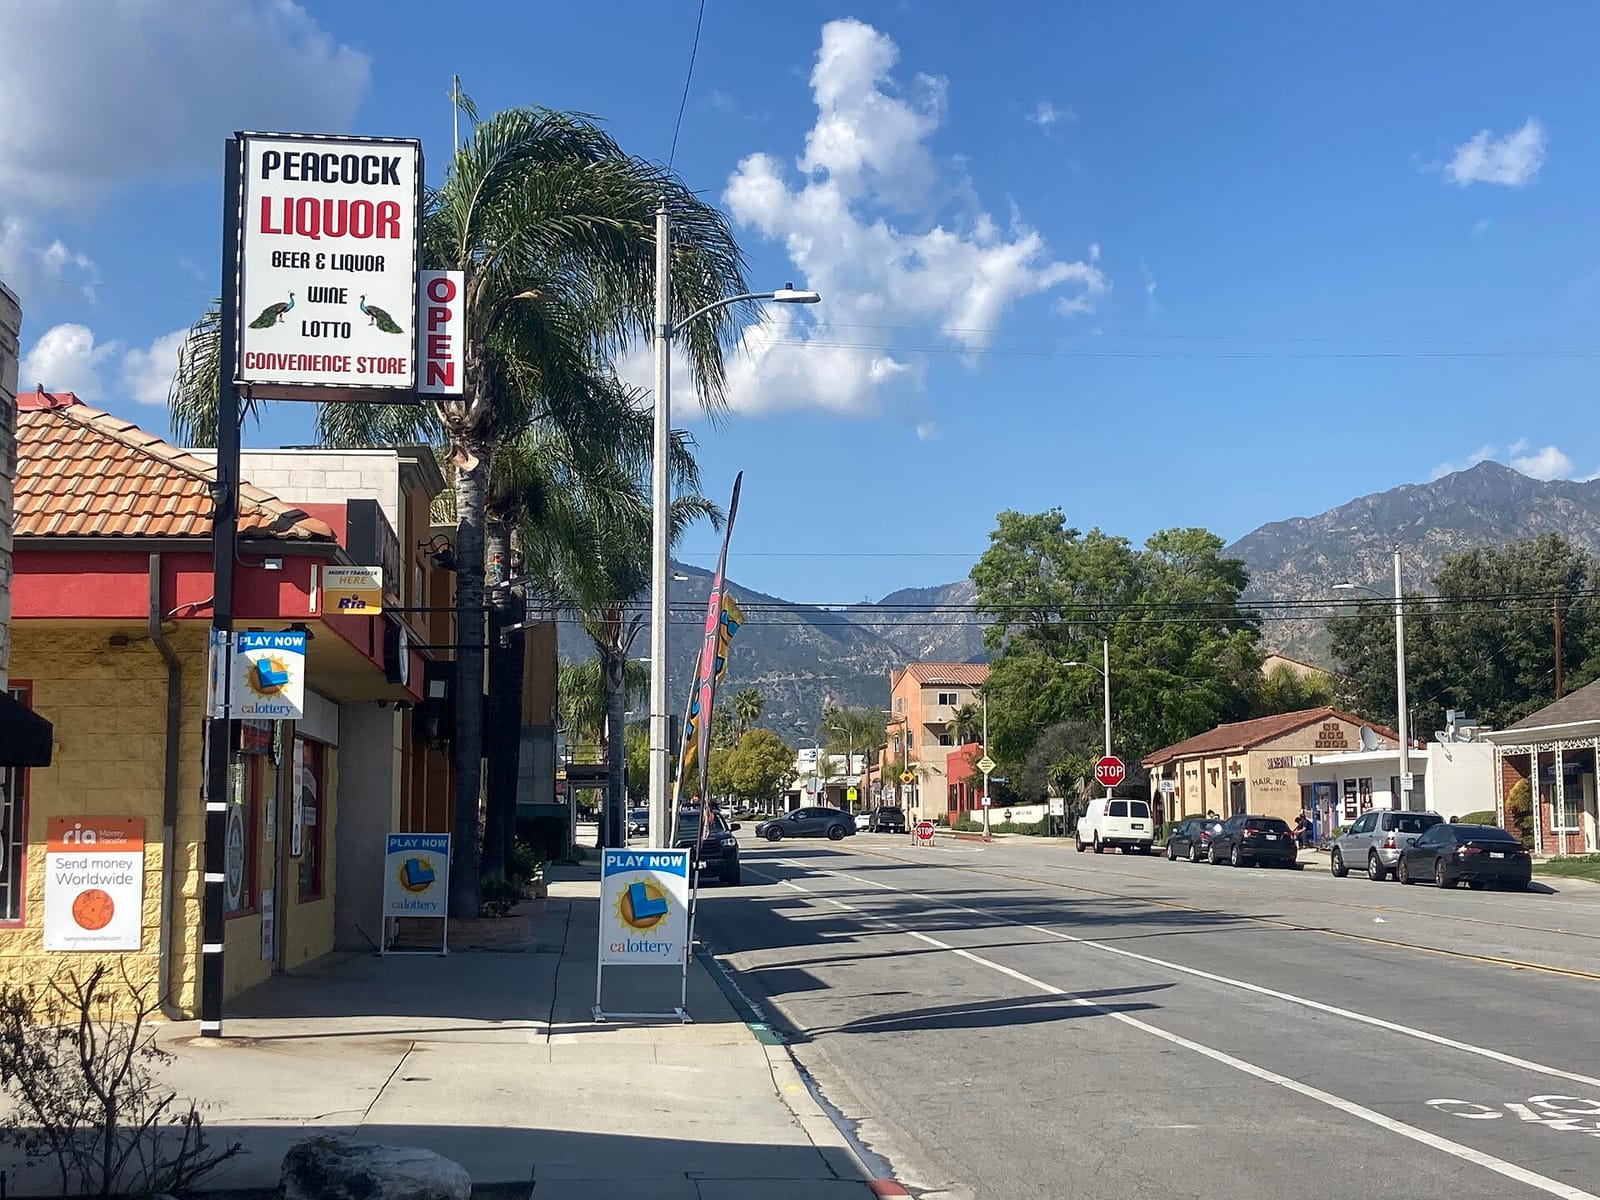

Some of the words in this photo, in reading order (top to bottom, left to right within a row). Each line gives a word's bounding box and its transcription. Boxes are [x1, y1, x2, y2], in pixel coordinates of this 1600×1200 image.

[261, 150, 401, 185] PEACOCK
[260, 196, 400, 240] LIQUOR
[272, 250, 310, 269] BEER
[315, 253, 325, 270] &
[331, 254, 385, 272] LIQUOR
[307, 286, 348, 305] WINE
[302, 320, 351, 339] LOTTO
[427, 278, 456, 387] OPEN
[245, 352, 351, 373] CONVENIENCE
[357, 356, 407, 375] STORE
[339, 576, 368, 585] HERE
[338, 593, 366, 609] Ria
[239, 636, 271, 647] PLAY
[274, 636, 304, 647] NOW
[241, 702, 291, 717] calottery
[1096, 765, 1123, 777] STOP
[63, 823, 97, 845] ria
[99, 829, 124, 839] Money
[916, 826, 934, 836] STOP
[390, 838, 418, 848] PLAY
[422, 839, 447, 848] NOW
[55, 857, 88, 870] Send
[91, 859, 133, 871] money
[606, 855, 645, 867] PLAY
[649, 855, 683, 867] NOW
[56, 872, 133, 886] Worldwide
[391, 898, 439, 911] calottery
[610, 938, 673, 957] calottery
